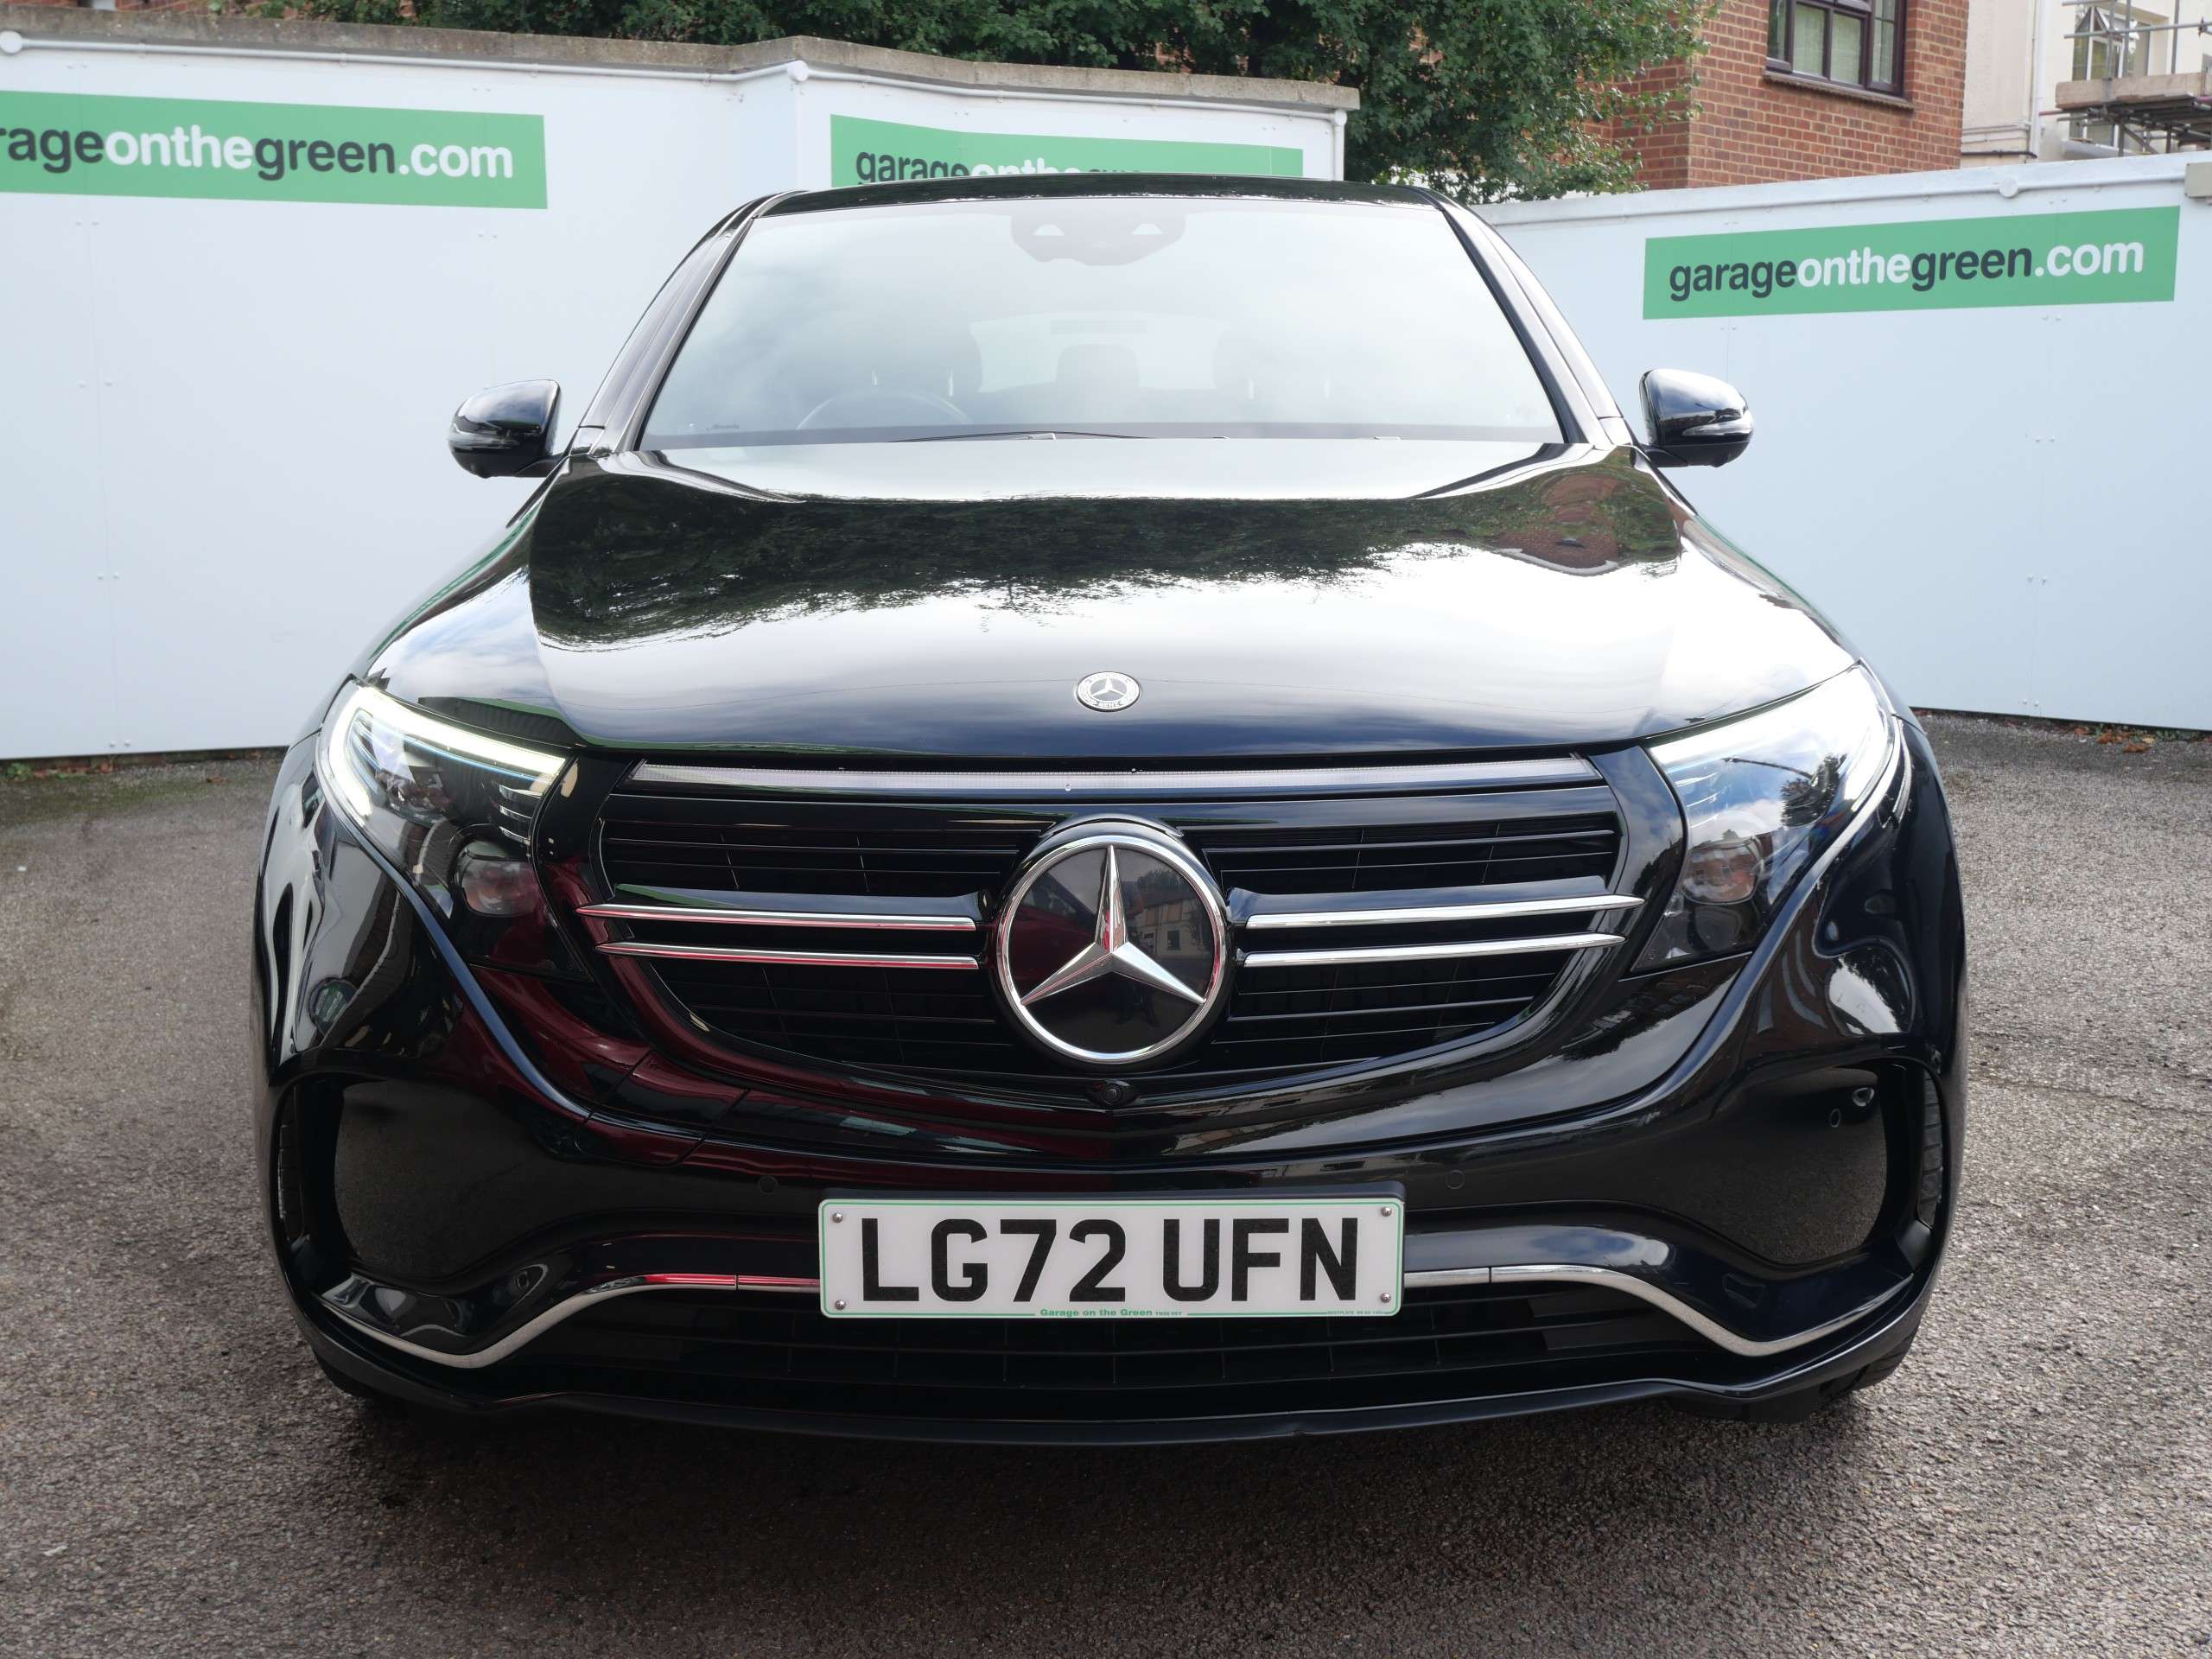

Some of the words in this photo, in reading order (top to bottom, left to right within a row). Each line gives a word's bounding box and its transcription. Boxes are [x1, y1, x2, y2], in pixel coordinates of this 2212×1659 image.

[1669, 241, 2144, 302] garageonthegreen.com
[861, 1217, 1125, 1302] LG72
[1163, 1217, 1358, 1301] UFN
[1039, 1308, 1079, 1318] Garage
